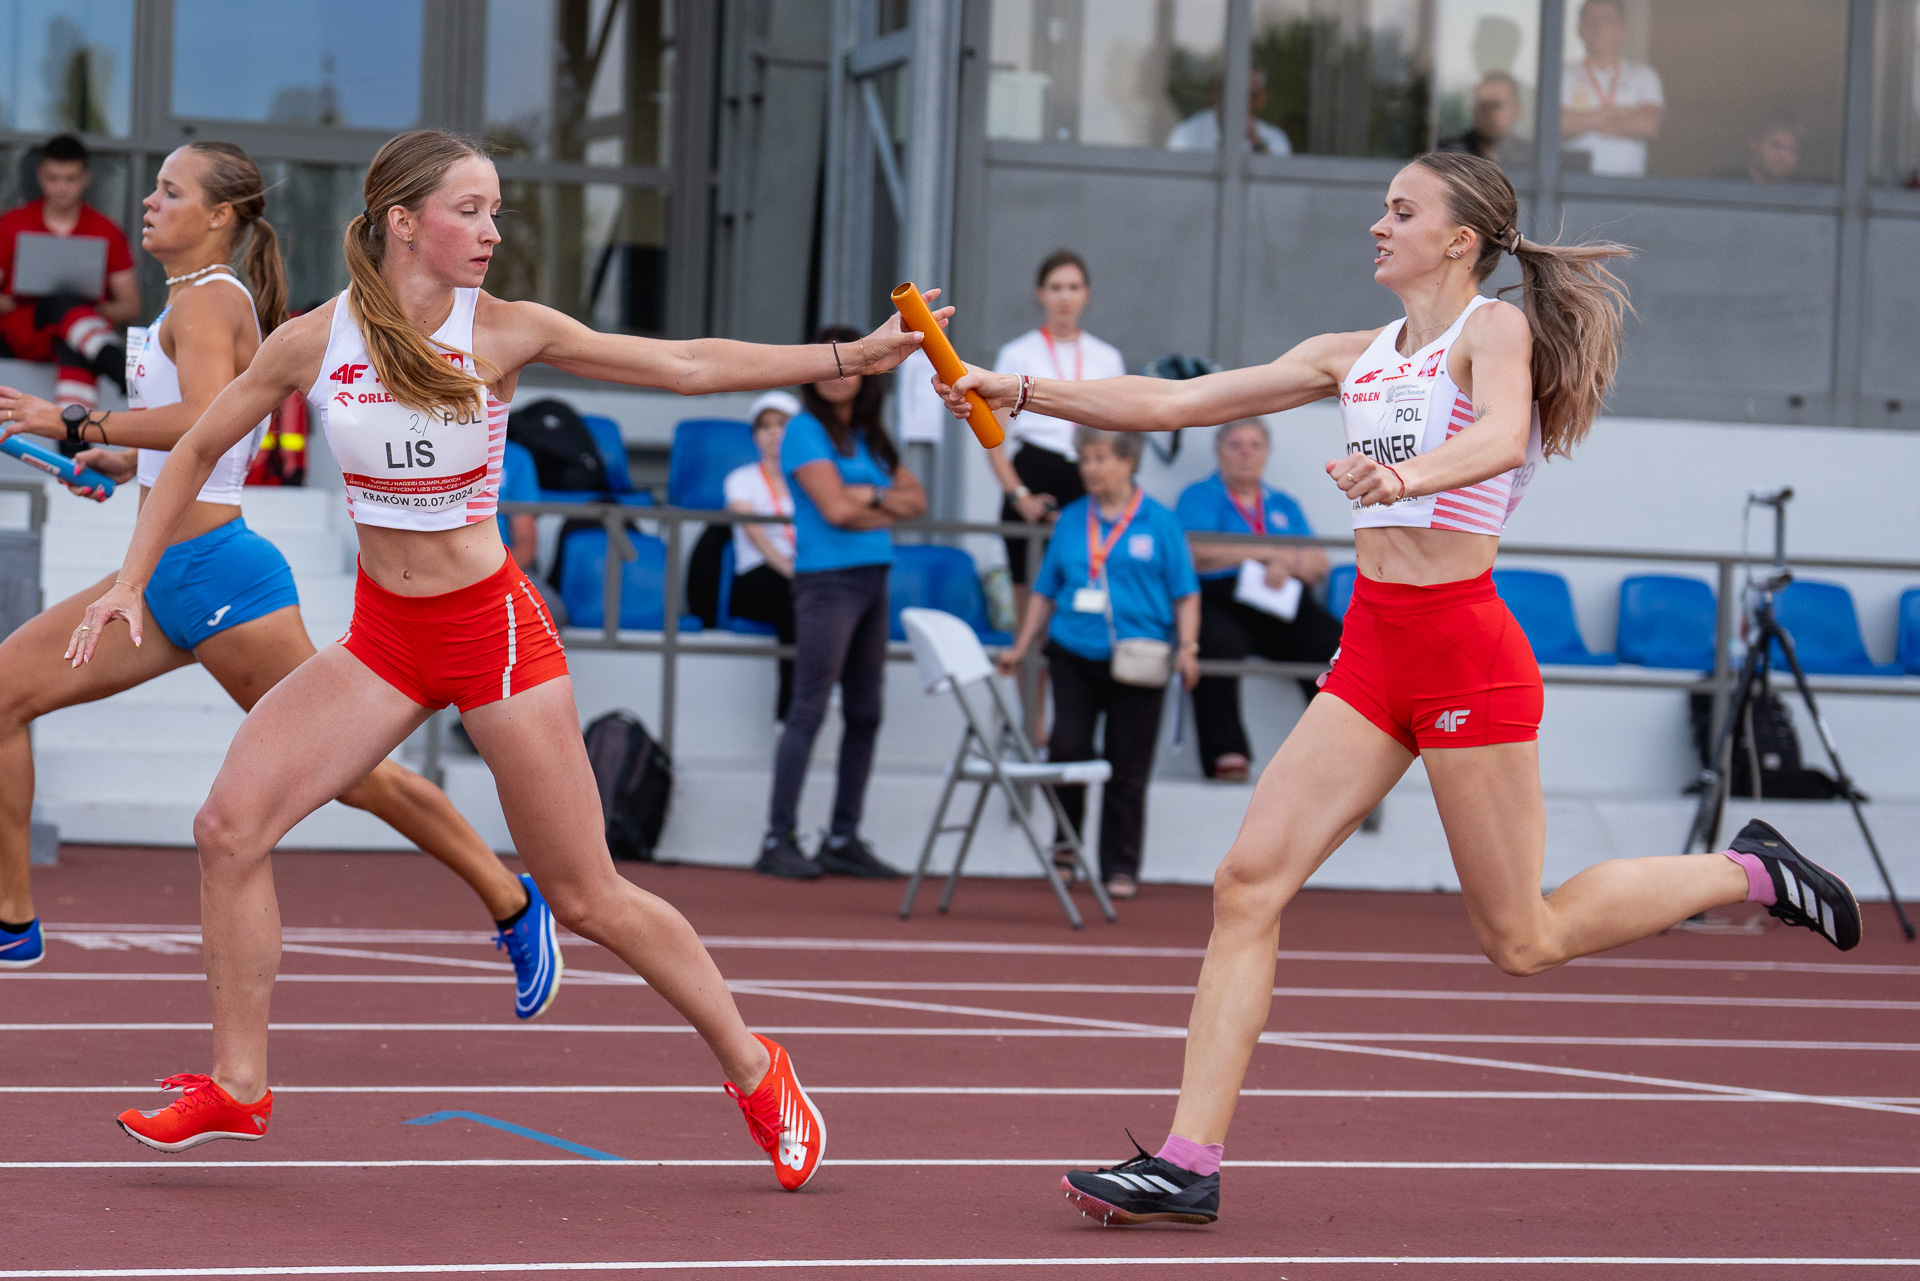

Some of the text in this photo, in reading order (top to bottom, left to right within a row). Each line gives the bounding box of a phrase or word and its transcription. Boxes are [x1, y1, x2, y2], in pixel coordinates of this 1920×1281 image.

[357, 392, 398, 404] ORLE
[1352, 391, 1381, 403] ORLEN
[1395, 407, 1422, 423] POL
[385, 440, 436, 469] LIS
[362, 487, 474, 507] KRAKÓW 20.07.2024
[1434, 709, 1471, 732] 4F
